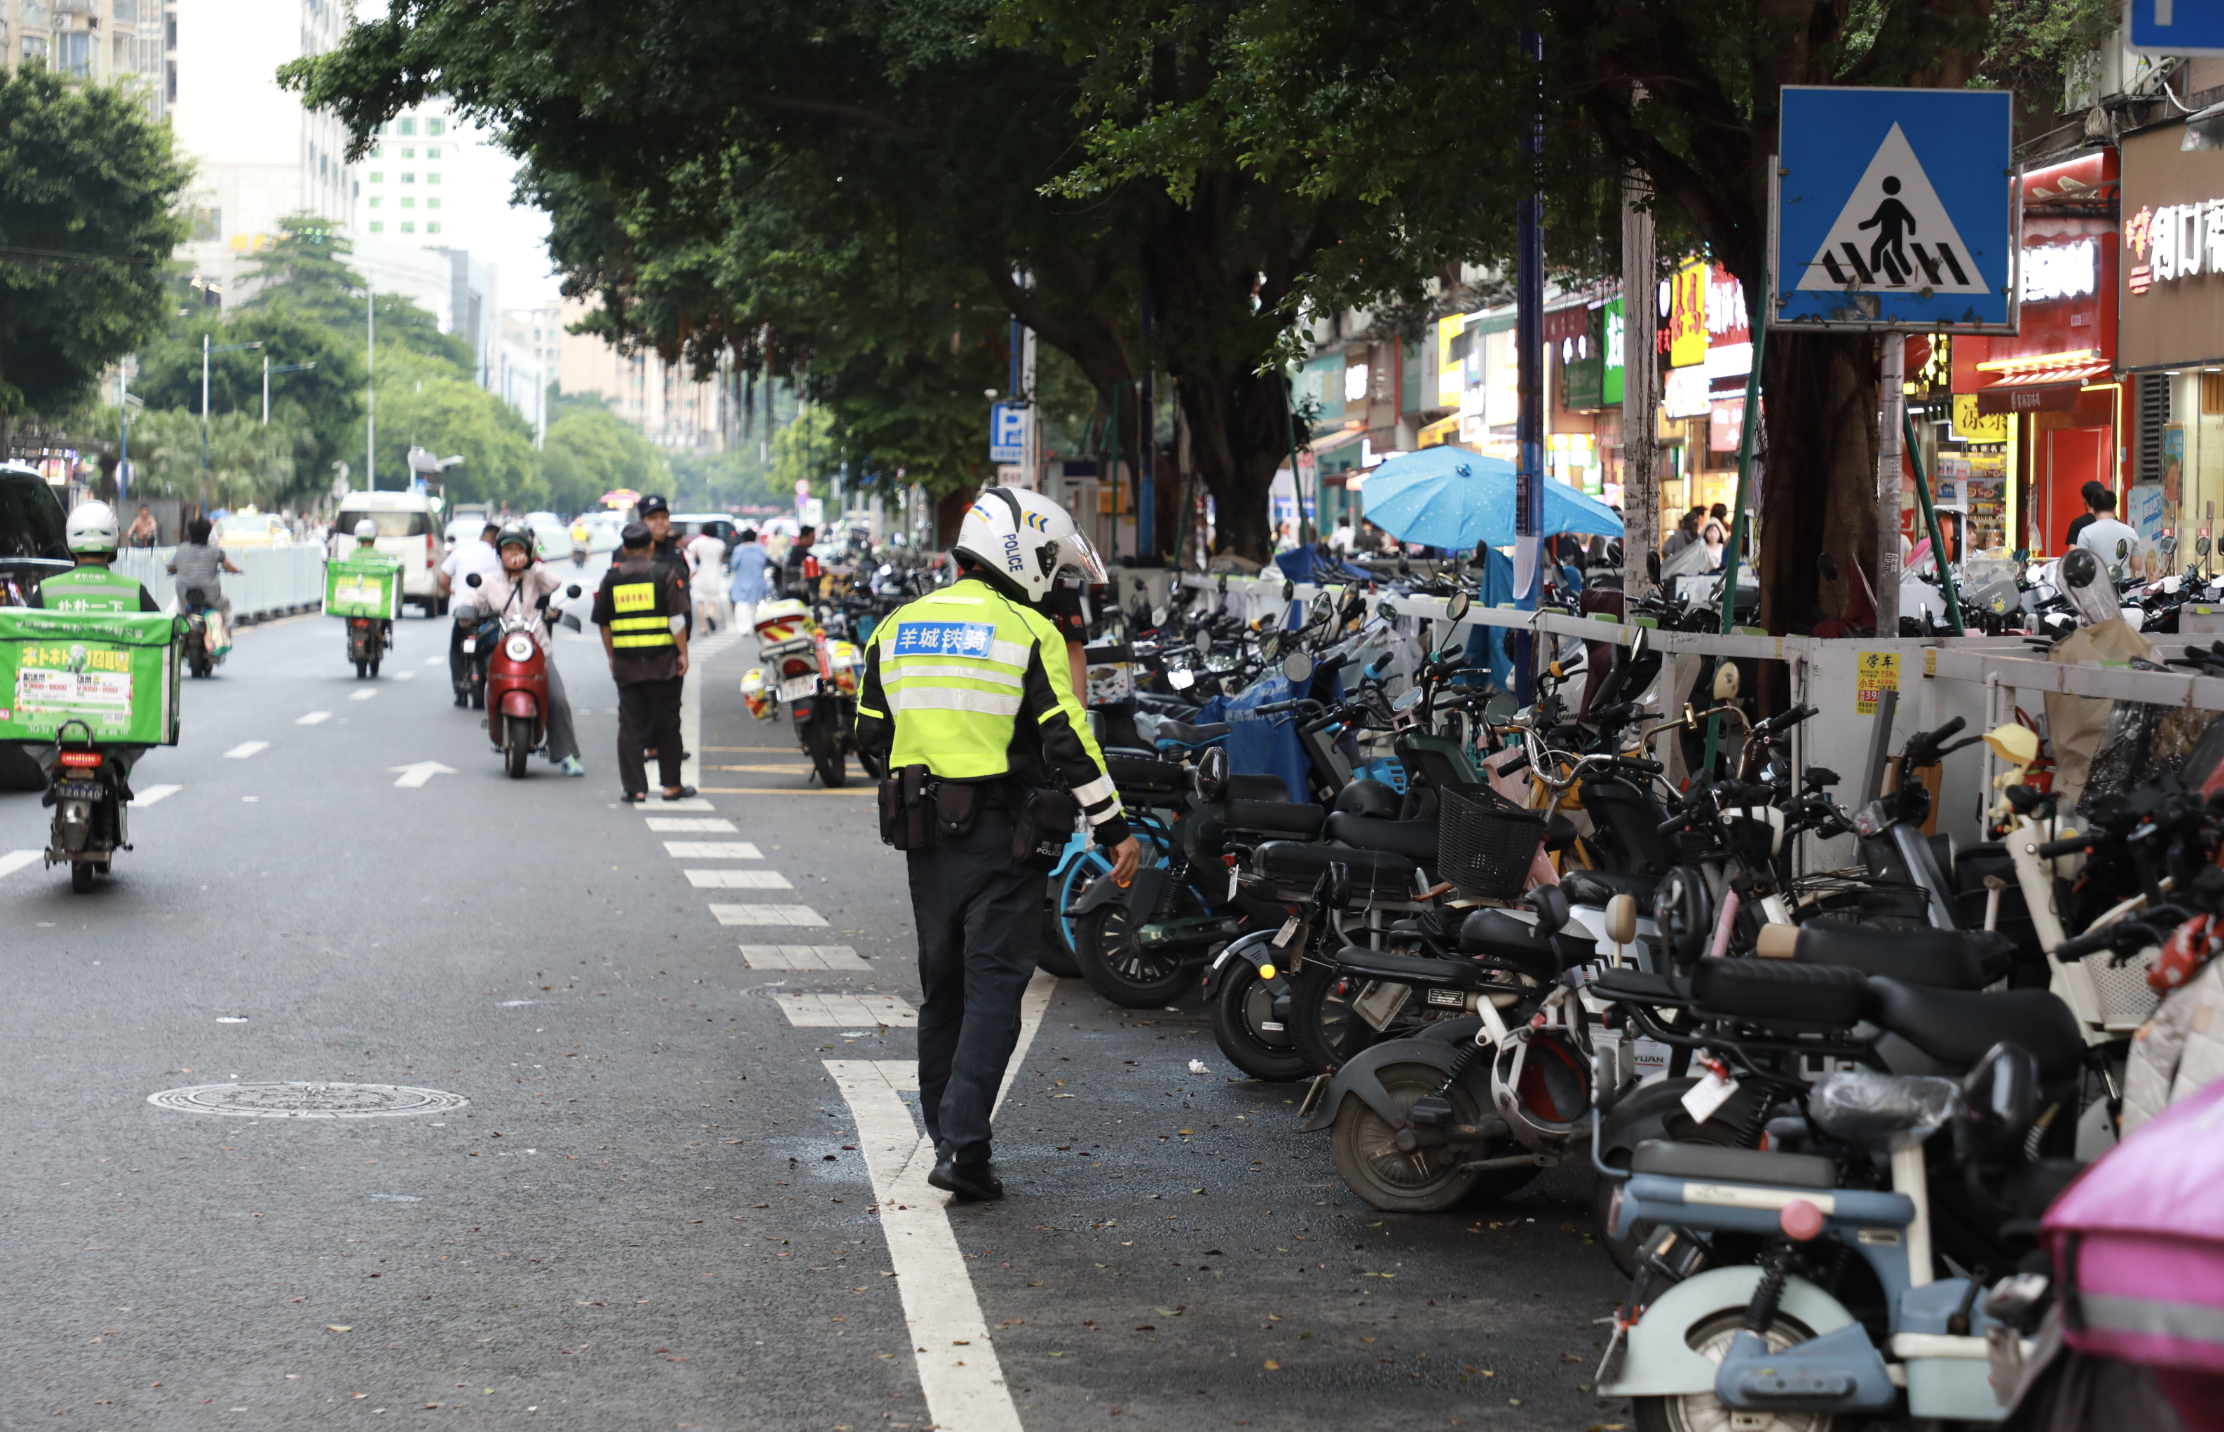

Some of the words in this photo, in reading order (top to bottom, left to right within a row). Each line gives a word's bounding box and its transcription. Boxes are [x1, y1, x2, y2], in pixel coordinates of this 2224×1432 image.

[1002, 533, 1023, 572] POLICE
[899, 628, 987, 651] 羊城铁骑
[1866, 654, 1894, 668] 学车
[1859, 678, 1875, 689] 小车
[1865, 690, 1879, 700] 39
